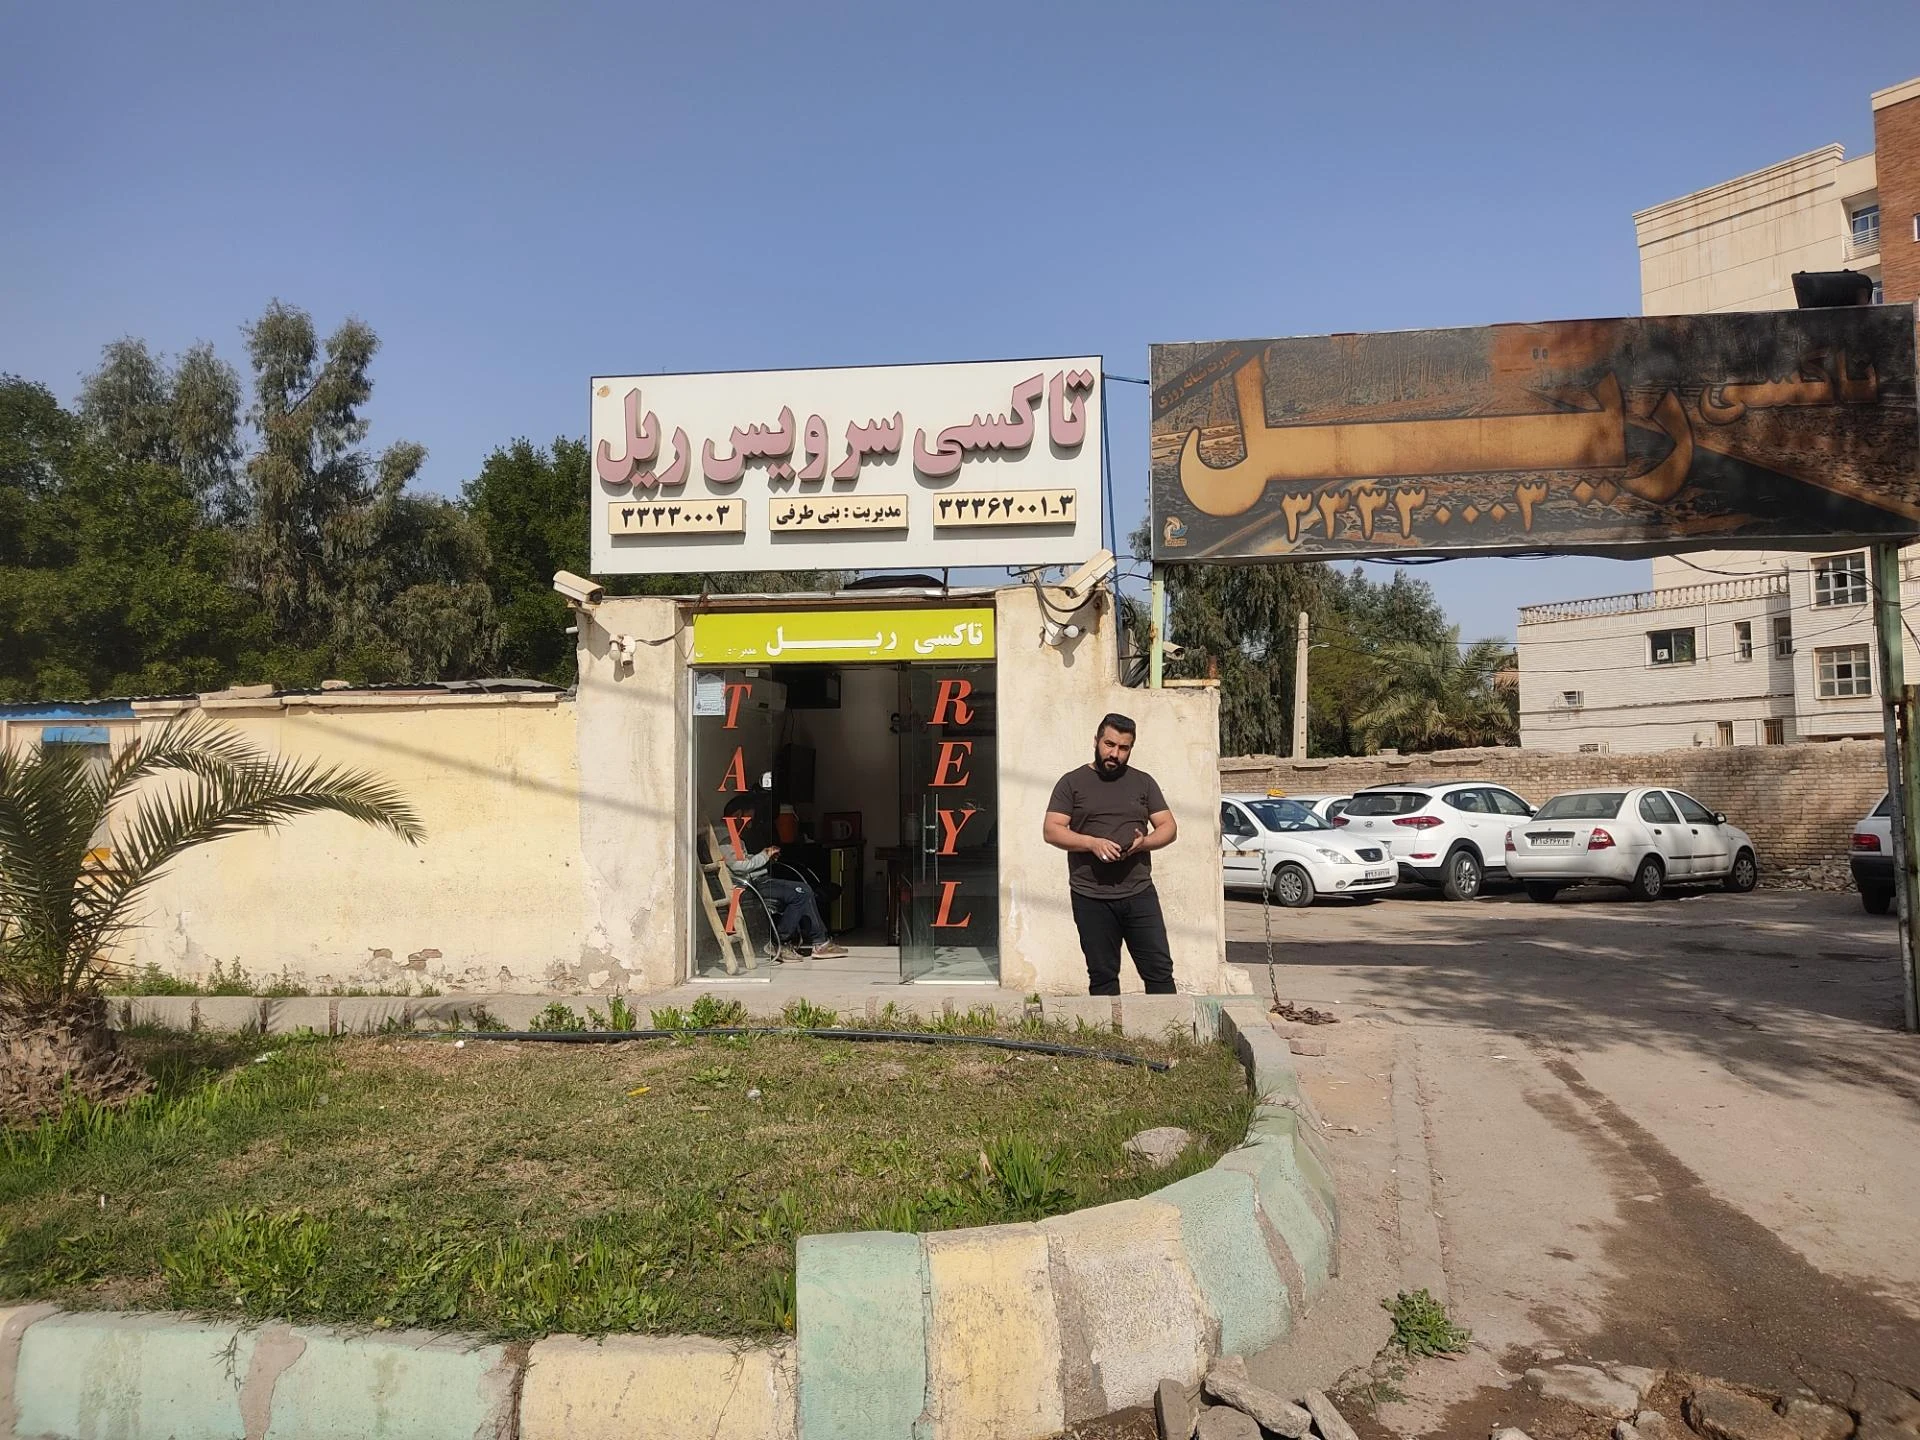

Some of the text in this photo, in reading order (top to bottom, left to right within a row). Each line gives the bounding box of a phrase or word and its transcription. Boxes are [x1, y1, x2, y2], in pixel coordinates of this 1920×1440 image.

[597, 369, 1094, 490] تاکسی سرویس ریل
[621, 504, 730, 528] ۳۳۳۳۰۰۰۳
[776, 504, 814, 525] طرفی
[913, 622, 984, 655] تاکسی
[926, 679, 975, 929] REYL
